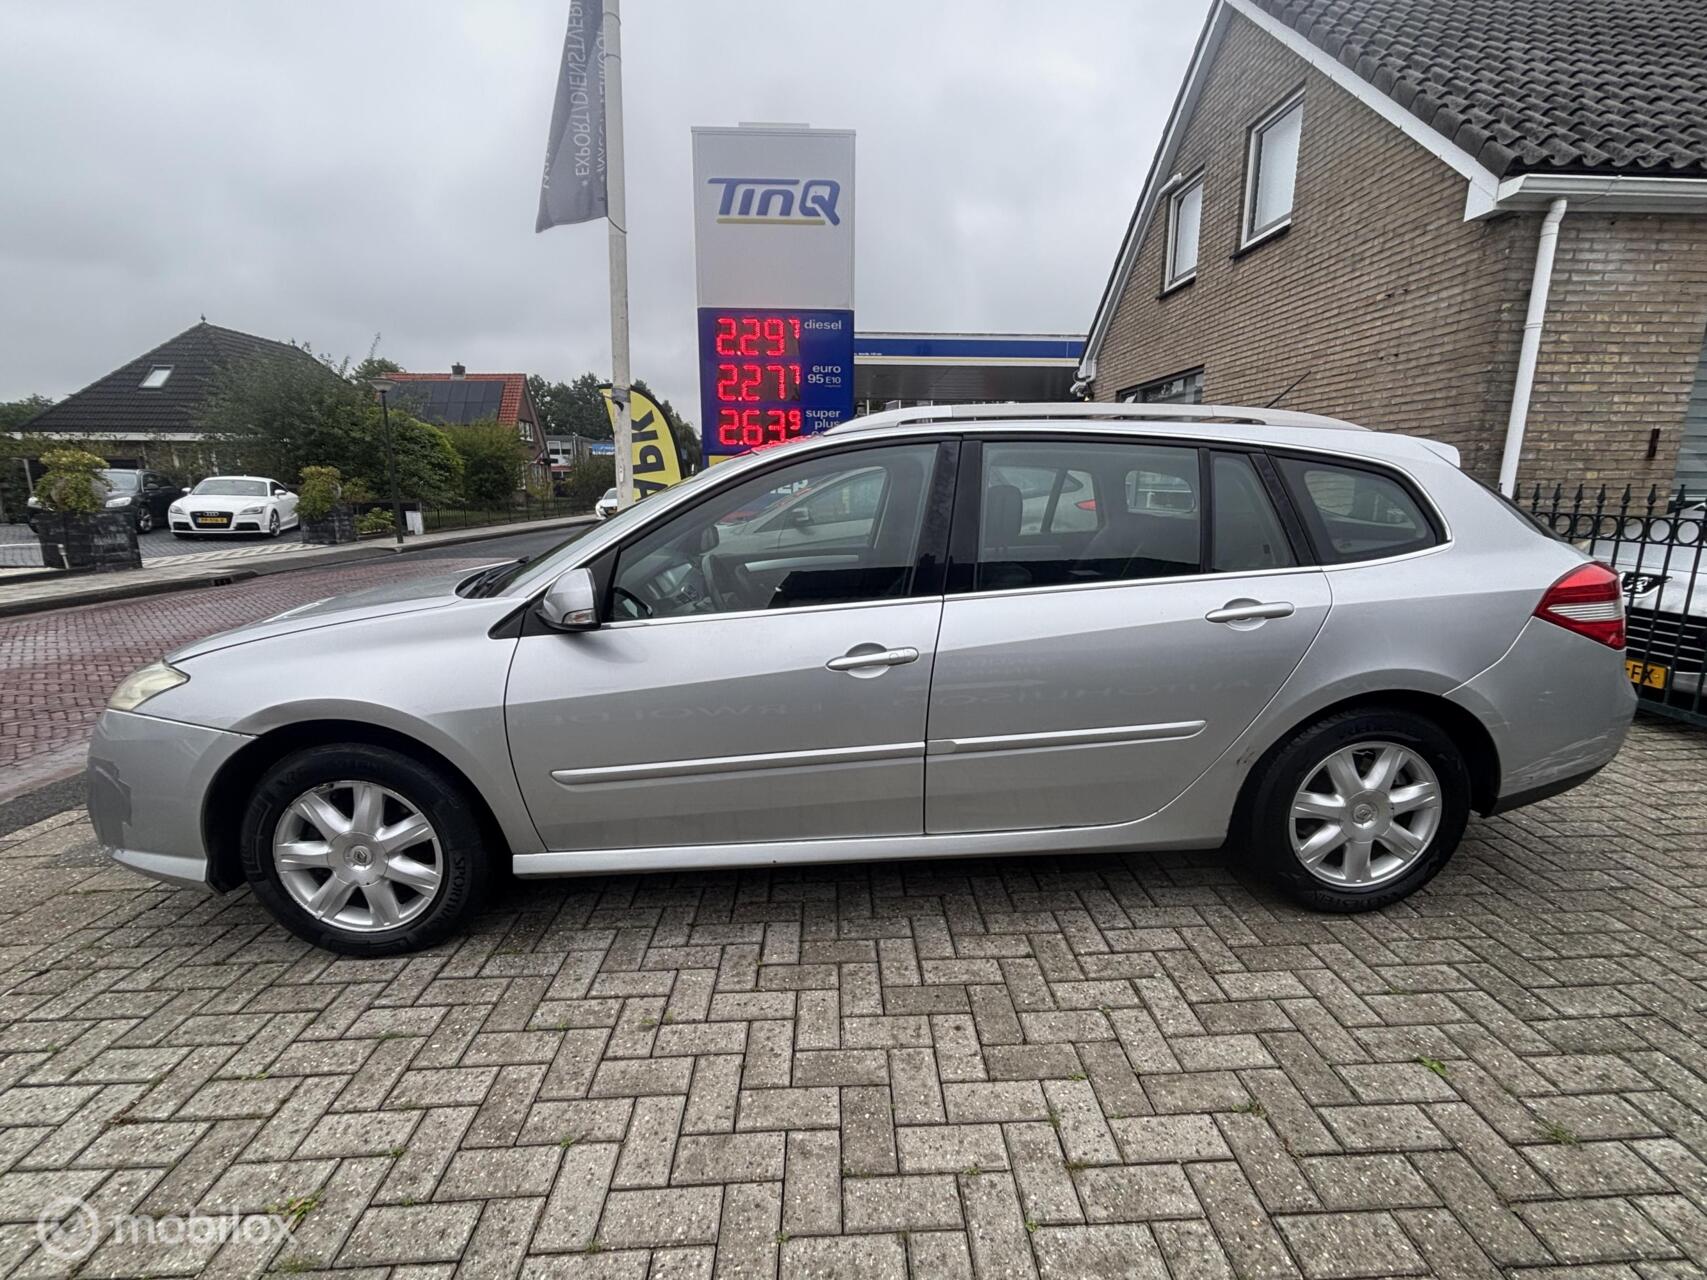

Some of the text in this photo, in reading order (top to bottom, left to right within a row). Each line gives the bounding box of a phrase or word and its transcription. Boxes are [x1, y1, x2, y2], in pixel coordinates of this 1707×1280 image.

[804, 320, 842, 330] diesel
[812, 365, 841, 374] euro
[807, 374, 824, 384] 95
[825, 376, 841, 384] E10
[805, 409, 841, 419] super
[814, 419, 841, 430] plus
